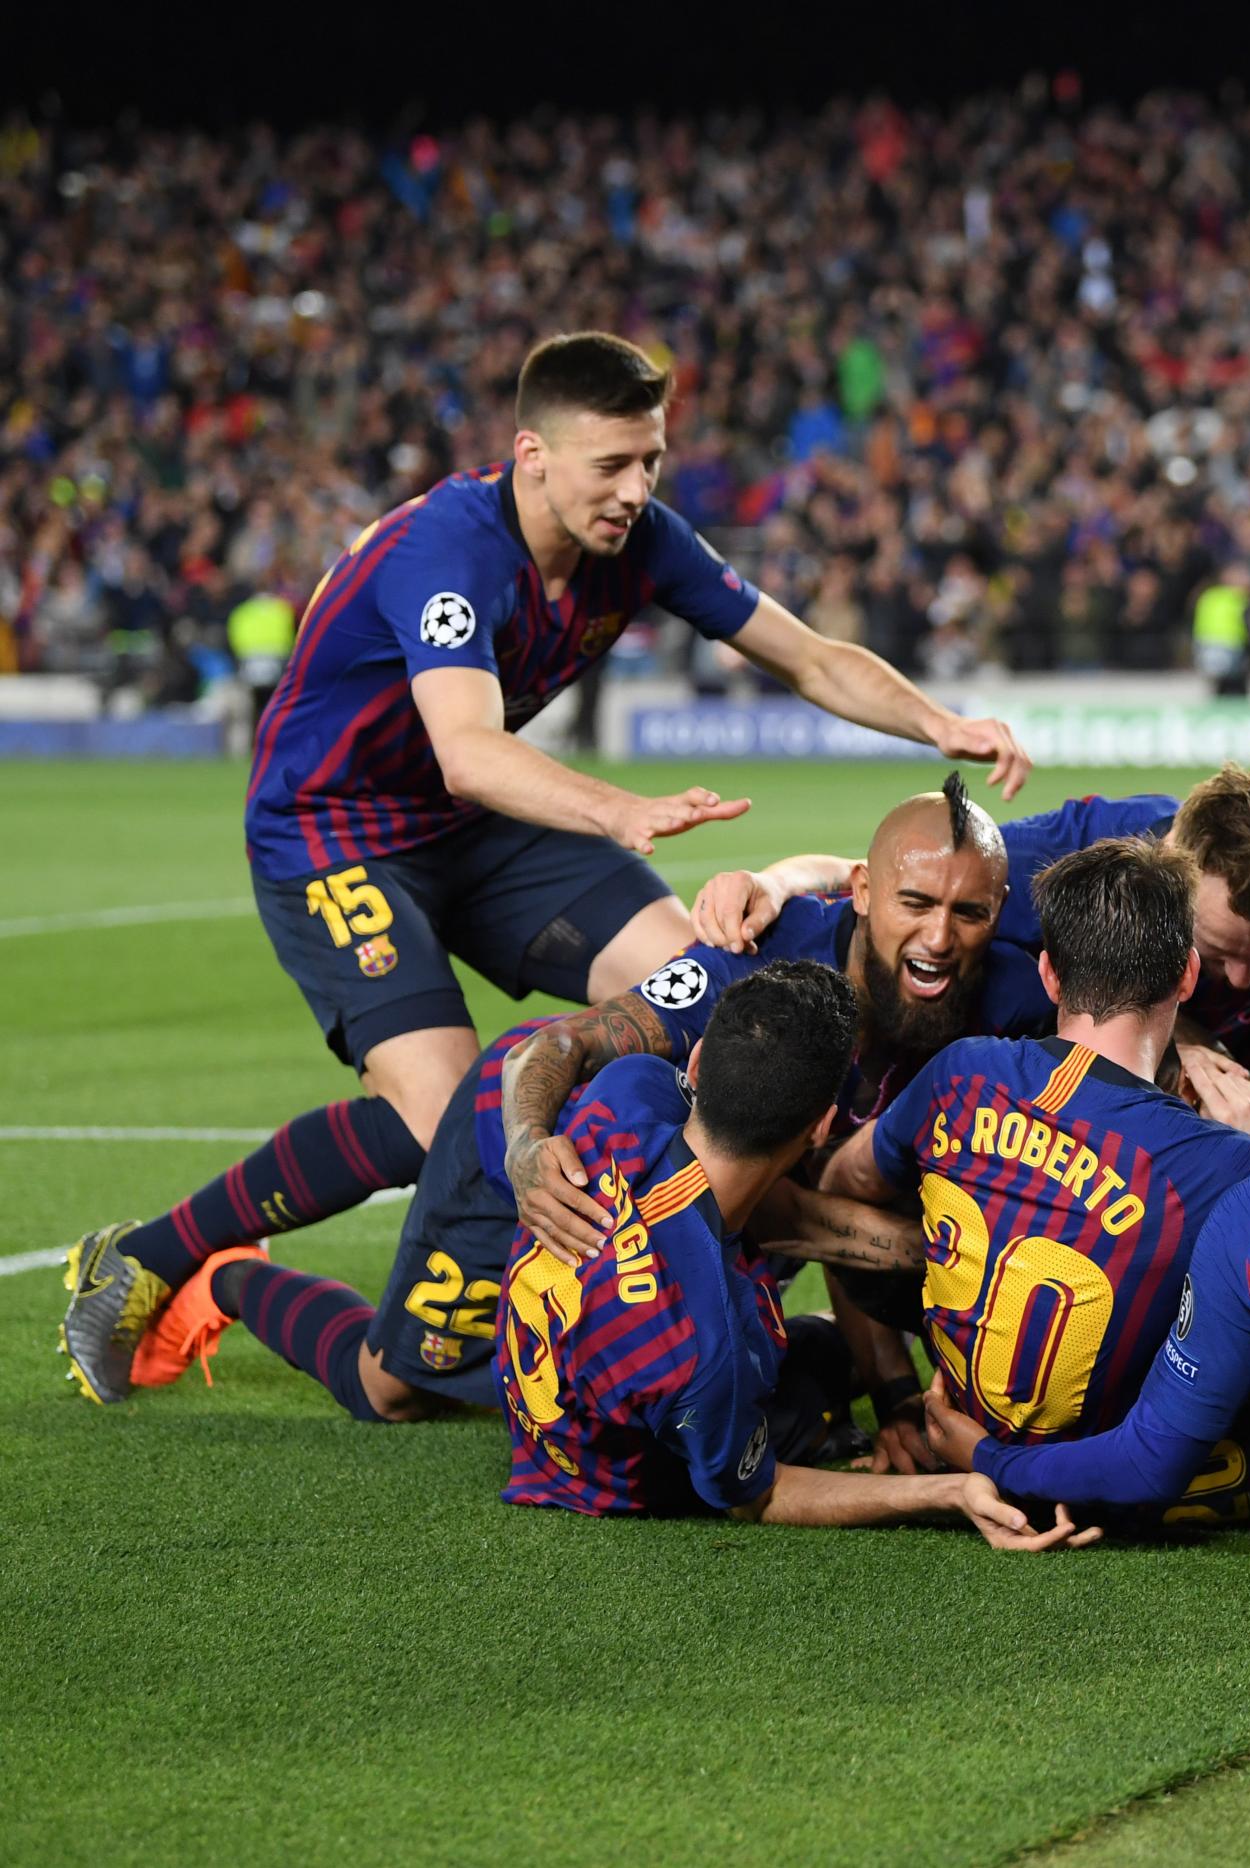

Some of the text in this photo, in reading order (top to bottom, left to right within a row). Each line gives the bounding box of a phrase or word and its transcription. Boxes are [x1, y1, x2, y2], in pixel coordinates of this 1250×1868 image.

[305, 864, 394, 948] 15
[932, 1106, 1146, 1236] S. ROBERTO
[404, 1249, 502, 1340] 22
[919, 1171, 1115, 1435] 20
